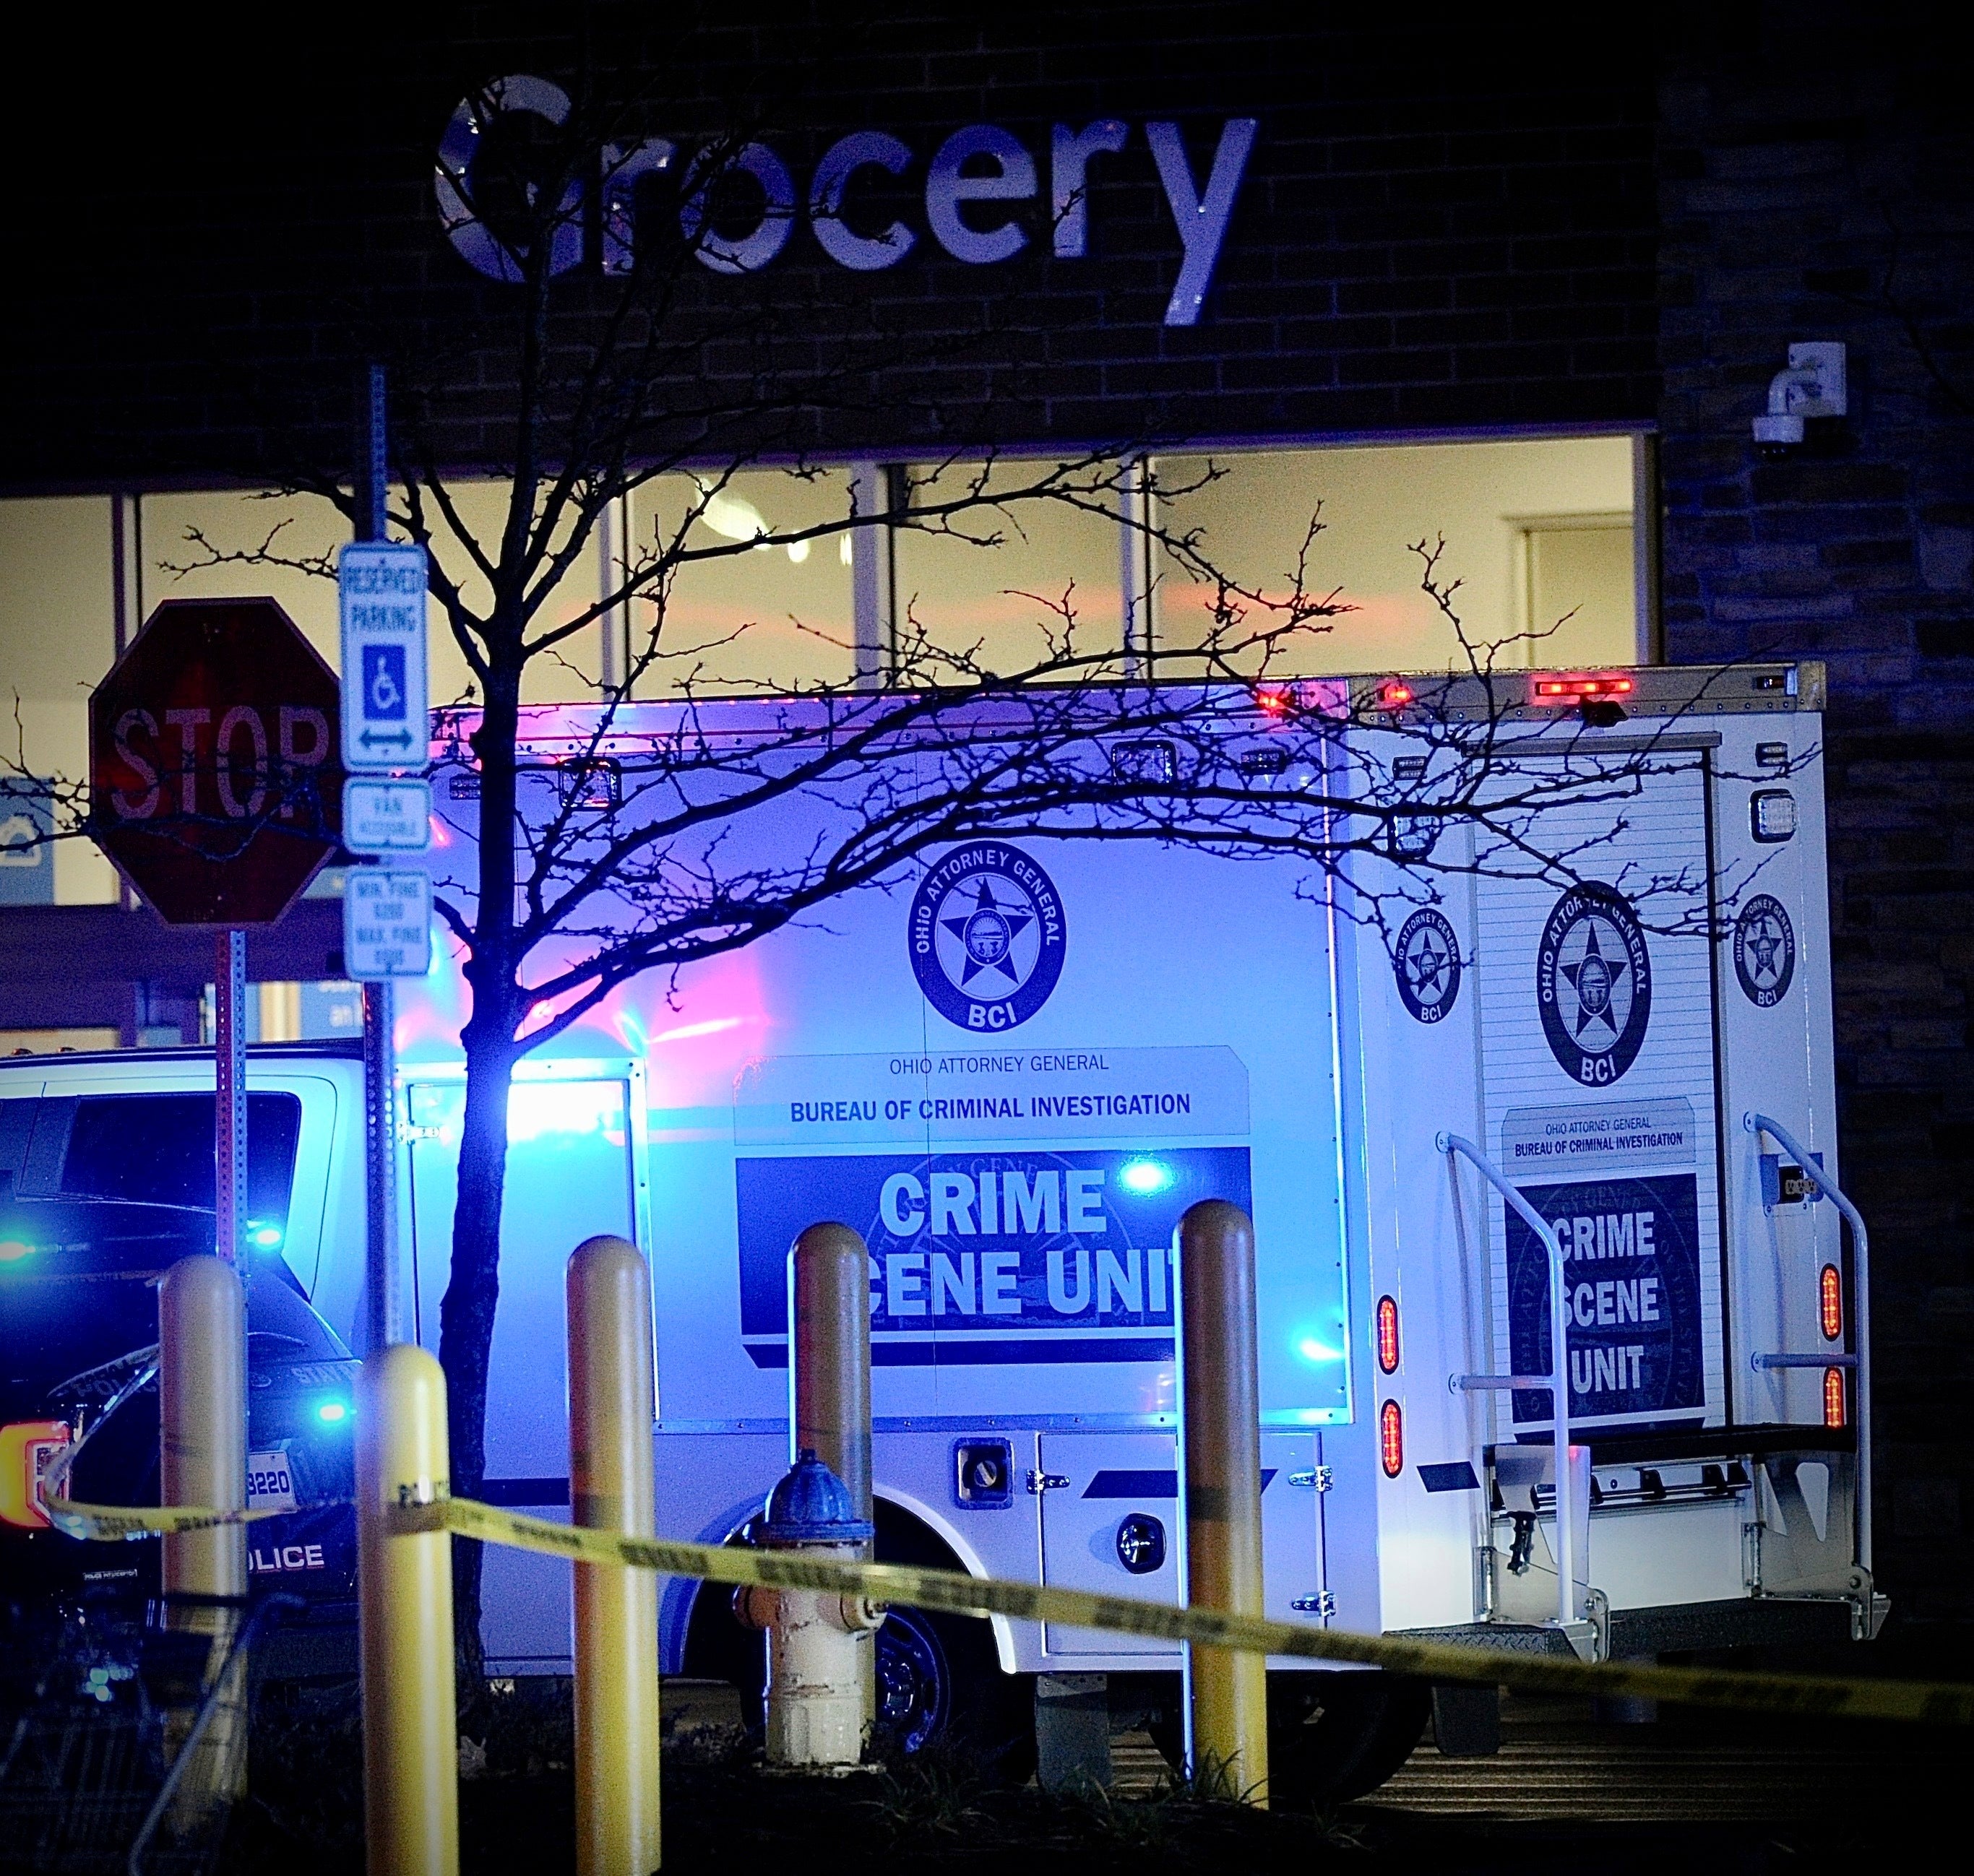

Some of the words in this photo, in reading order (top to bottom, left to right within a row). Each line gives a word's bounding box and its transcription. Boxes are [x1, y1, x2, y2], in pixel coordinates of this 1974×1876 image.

[434, 74, 1259, 327] Grocery
[351, 604, 417, 633] PARKING
[111, 705, 329, 819] STOP
[915, 905, 932, 954] OHIO
[926, 849, 1010, 902] ATTORNEY
[1013, 860, 1060, 946] GENERAL
[1401, 912, 1436, 946] ATTORNEY
[1773, 905, 1793, 954] GENERAL
[1543, 951, 1553, 1003] OHIO
[1549, 896, 1608, 947] ATTOR
[1421, 1005, 1442, 1021] BCI
[1758, 990, 1777, 1006] BCI
[967, 1001, 1017, 1029] BCI
[889, 1057, 932, 1075] OHIO
[938, 1055, 1024, 1074] ATTORNEY
[1030, 1053, 1109, 1072] GENERAL
[1580, 1054, 1617, 1083] BCI
[790, 1099, 876, 1123] BUREAU
[884, 1099, 912, 1121] OF
[918, 1096, 1025, 1120] CRIMINAL
[1031, 1093, 1191, 1118] INVESTIGATION
[1545, 1123, 1567, 1136] OHIO
[1569, 1119, 1611, 1134] ATTORNEY
[1613, 1117, 1652, 1131] GENERAL
[1514, 1141, 1553, 1157] BUREAU
[1554, 1140, 1567, 1154] OF
[1569, 1136, 1615, 1153] CRIMINAL
[1616, 1132, 1684, 1150] INVESTIGATION
[879, 1169, 1107, 1237] CRIME
[1552, 1211, 1655, 1261] CRIME
[1046, 1248, 1175, 1314] UNI
[1571, 1344, 1645, 1394] UNIT
[248, 1544, 325, 1570] LICE
